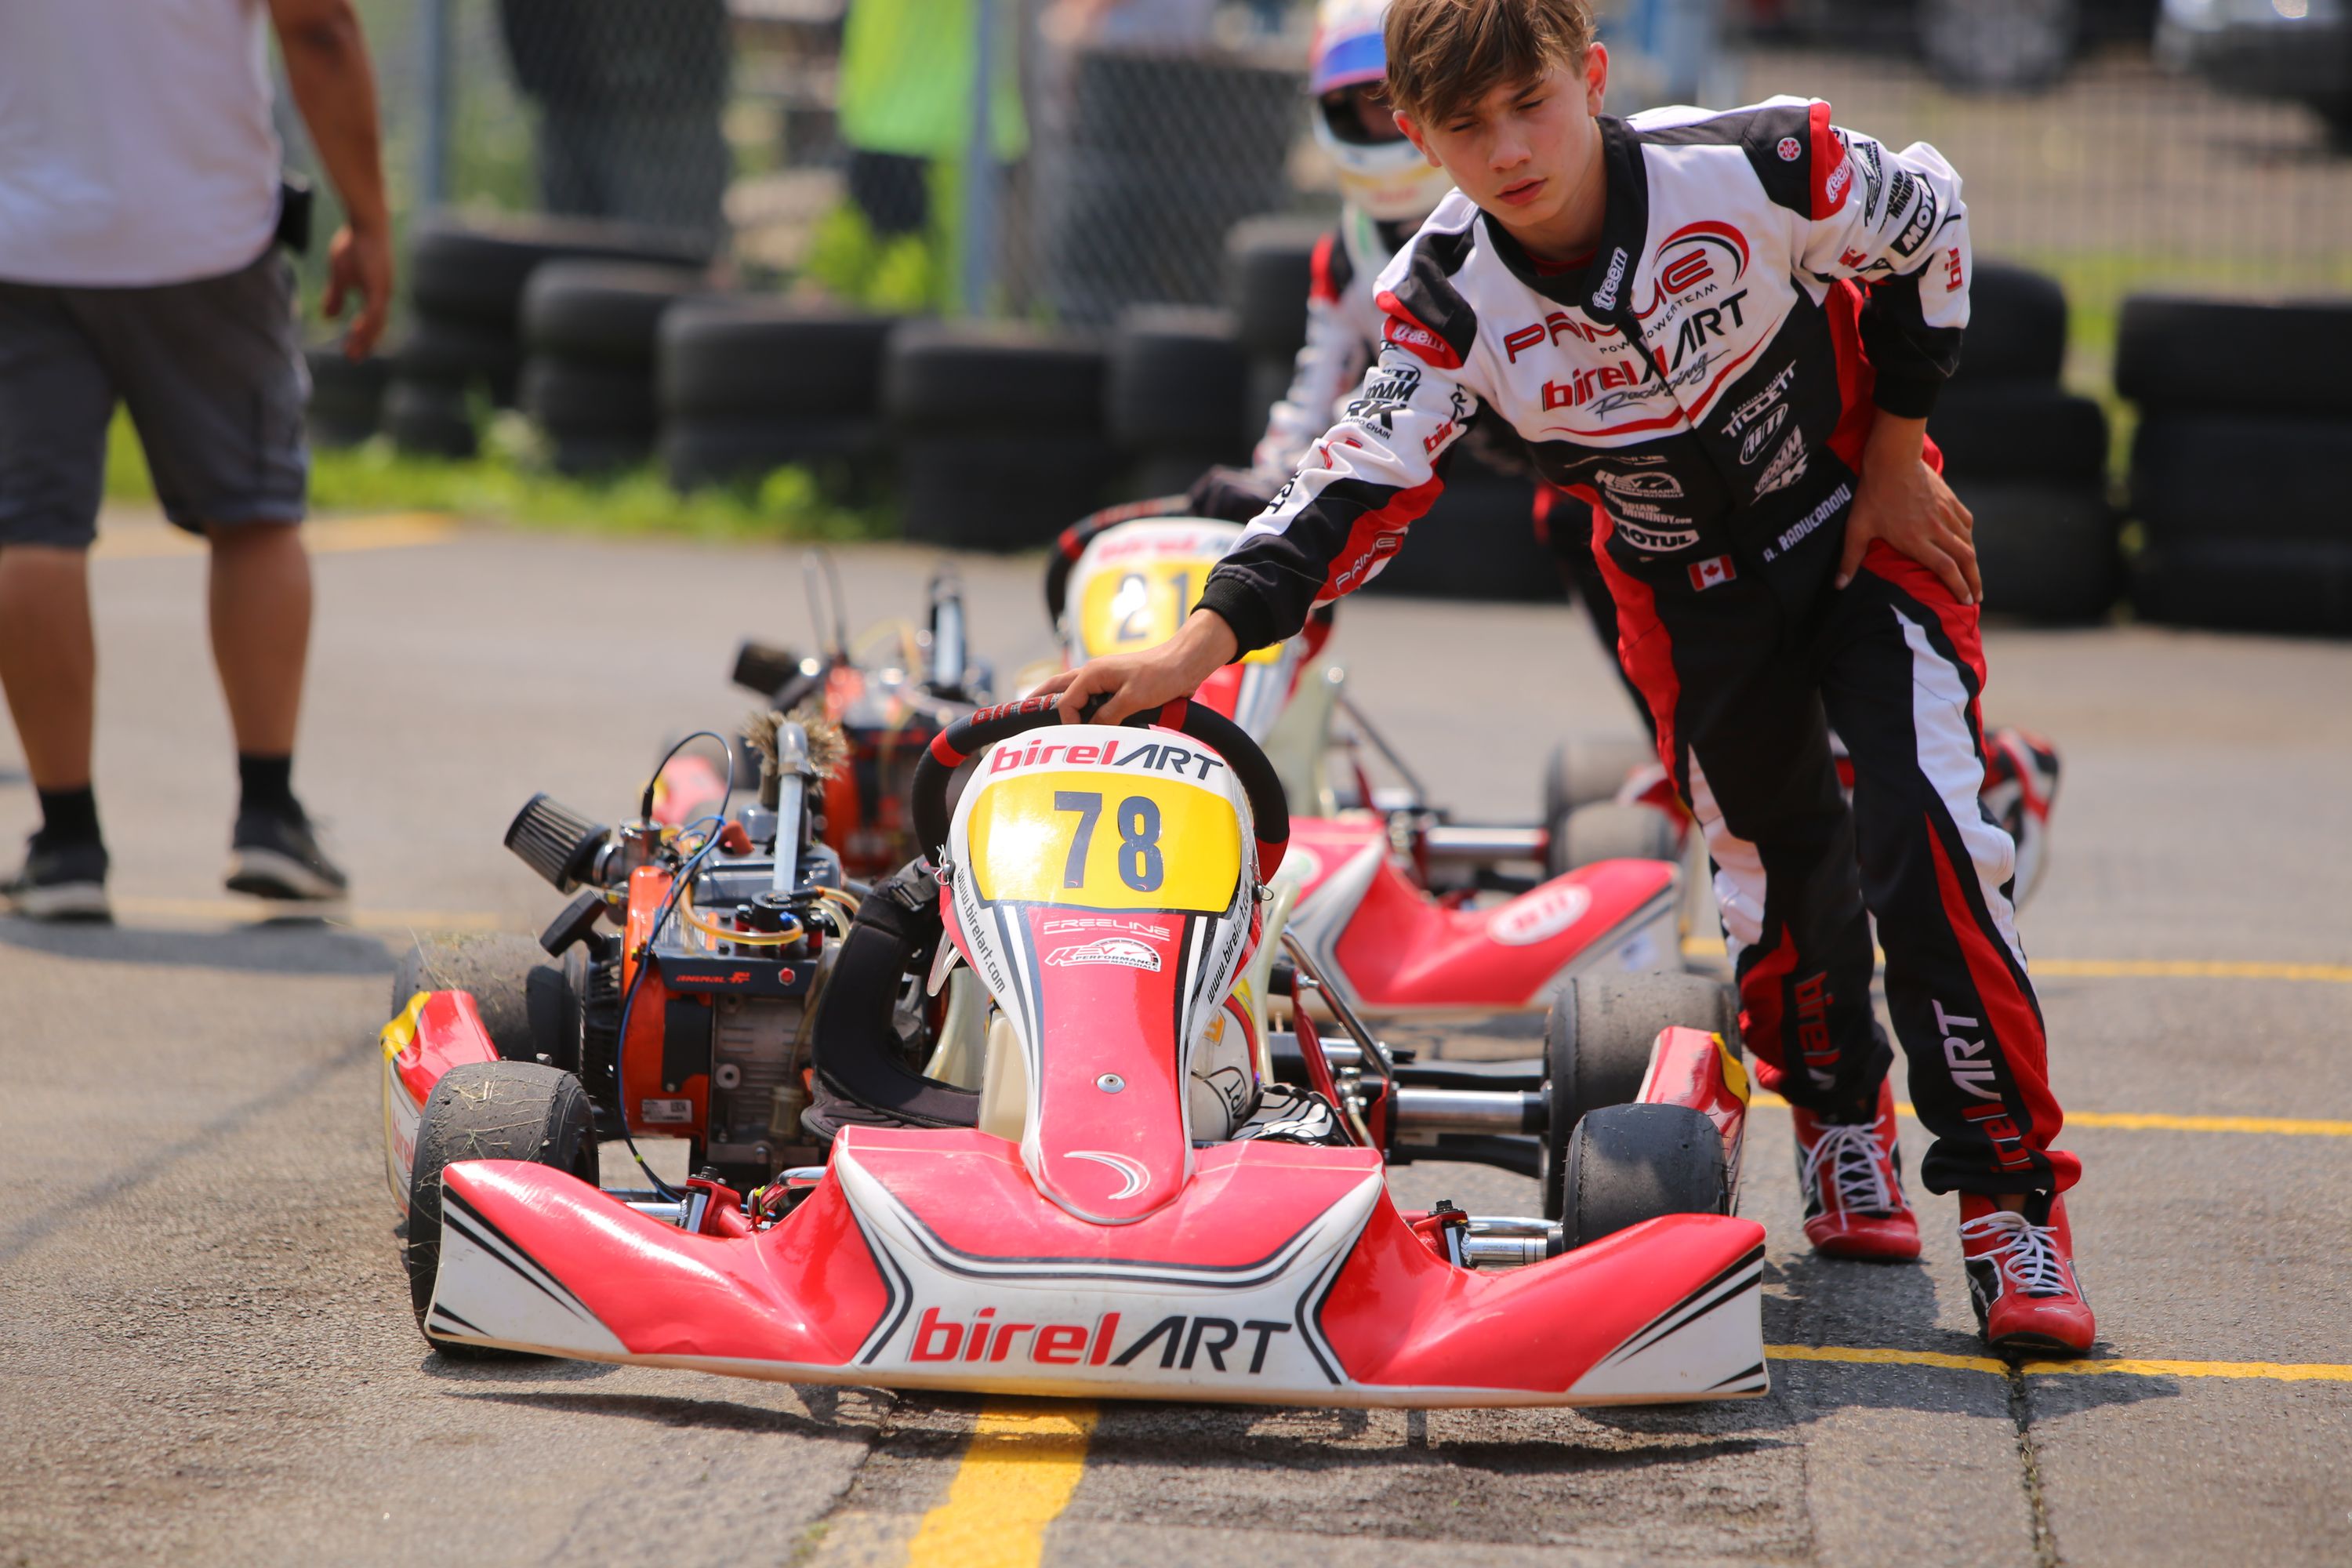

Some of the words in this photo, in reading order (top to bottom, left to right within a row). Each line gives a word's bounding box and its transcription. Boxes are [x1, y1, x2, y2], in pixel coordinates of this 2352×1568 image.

[1592, 247, 1628, 311] freem
[1366, 422, 1391, 440] CHAIN
[1116, 572, 1189, 642] 21
[989, 739, 1224, 780] birelART
[1054, 791, 1164, 892] 78
[957, 868, 1006, 994] www.birelart.com
[1044, 918, 1171, 938] FREELINE
[1075, 954, 1159, 967] PERFORMANCE
[1110, 960, 1159, 971] MATERIALS
[908, 1306, 1293, 1374] birelART
